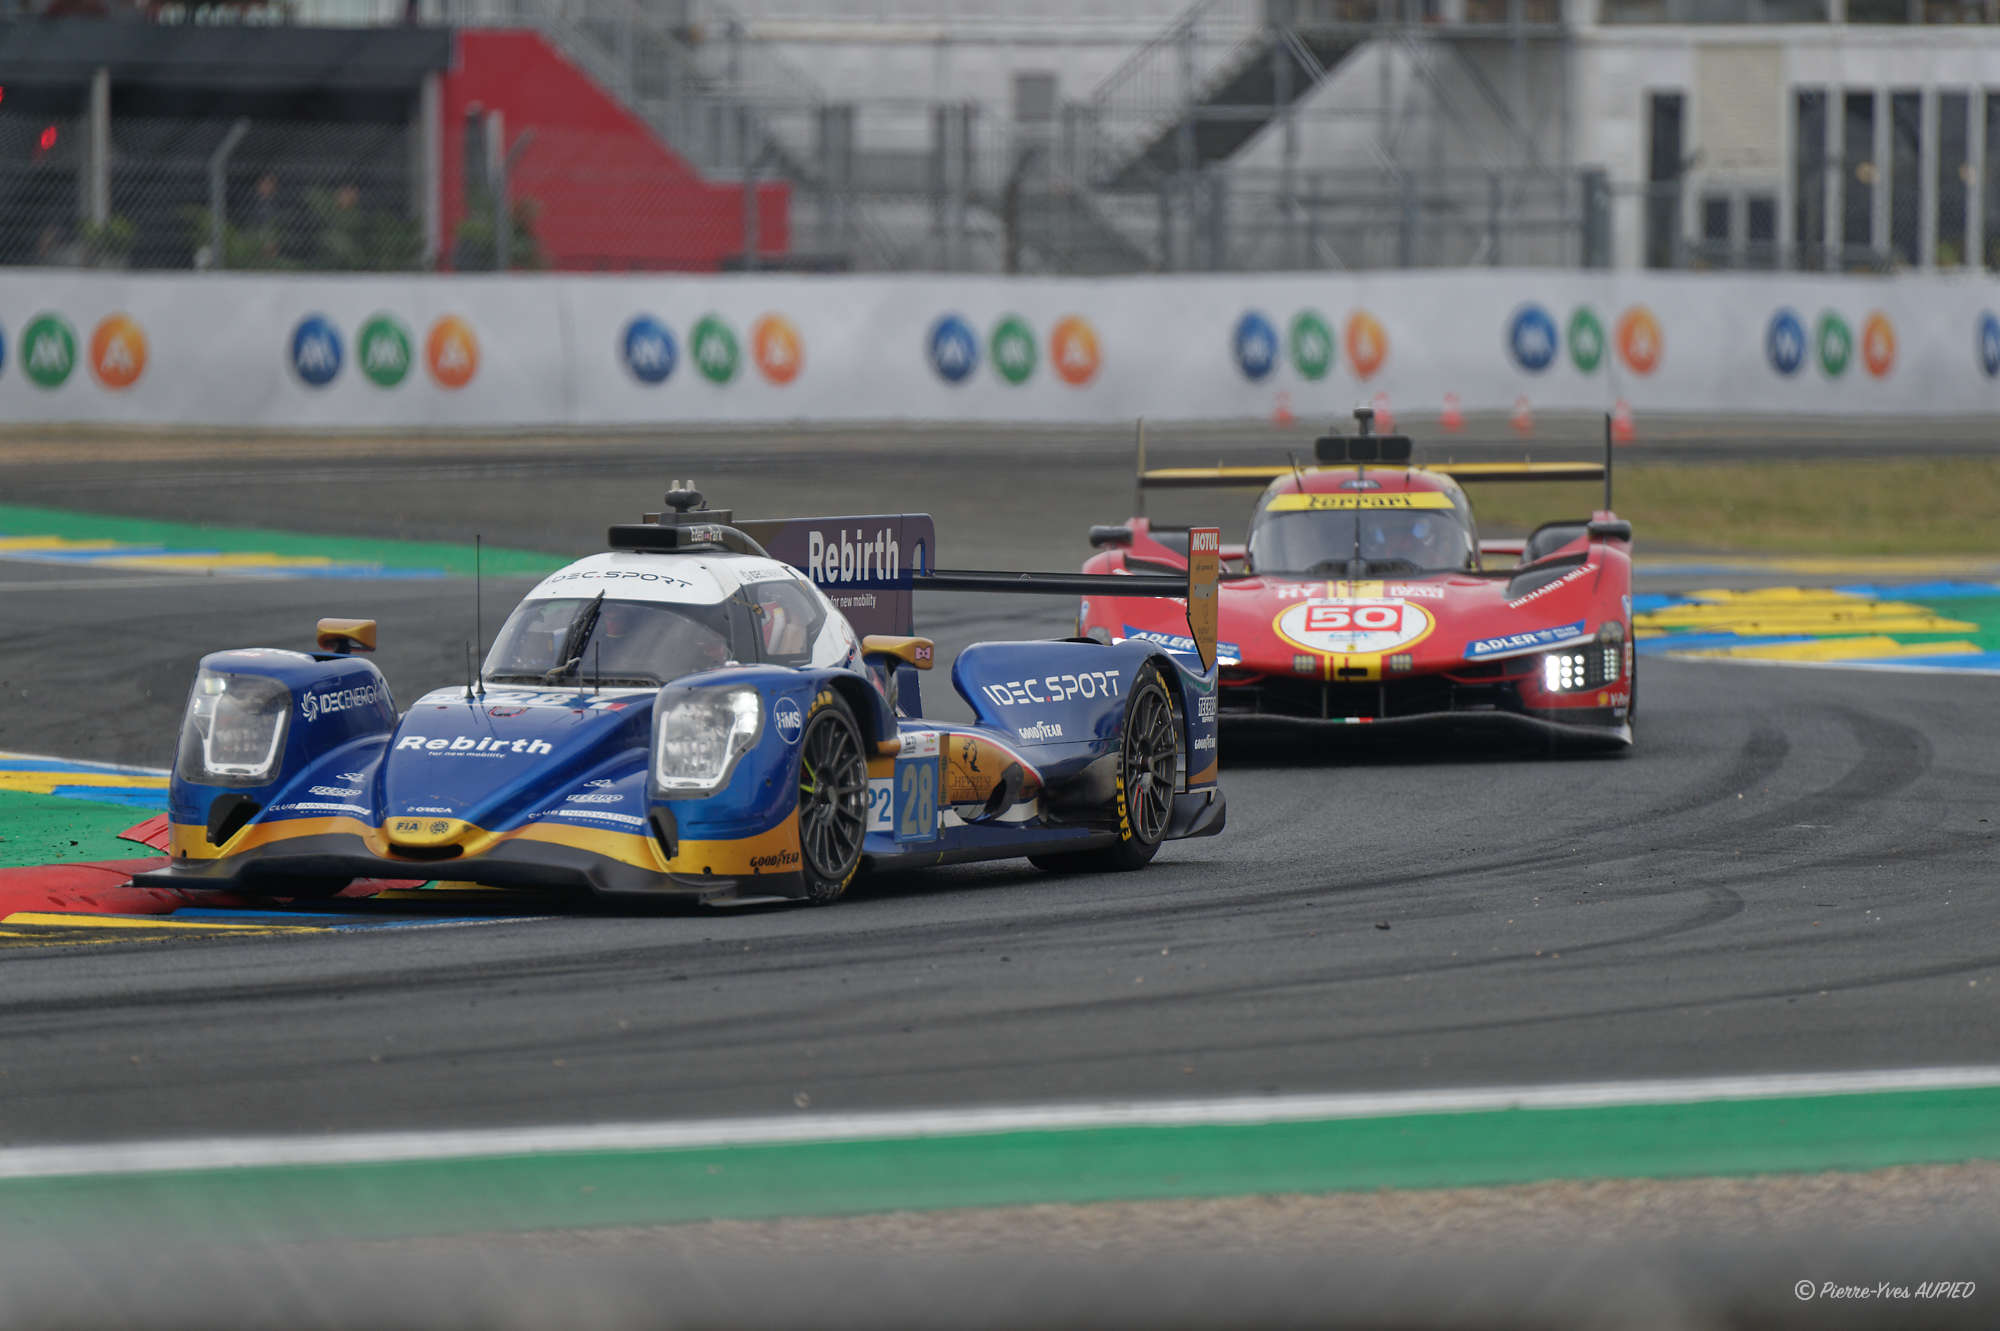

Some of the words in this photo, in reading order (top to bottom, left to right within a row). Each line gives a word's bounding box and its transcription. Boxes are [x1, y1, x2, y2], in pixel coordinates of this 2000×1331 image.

[1308, 493, 1413, 508] Ferrari
[1192, 532, 1219, 551] MOTUL
[808, 528, 899, 583] Rebirth
[1509, 579, 1564, 608] RICHARD
[1563, 562, 1597, 582] MILLE
[840, 595, 852, 608] new
[853, 592, 877, 609] mobility
[1309, 607, 1400, 629] 50
[1474, 633, 1538, 653] ADLER
[1019, 721, 1063, 741] GOODYEAR
[396, 735, 553, 755] Rebirth
[902, 763, 934, 835] 28
[1116, 776, 1132, 841] EAGLE
[396, 822, 418, 831] FIA
